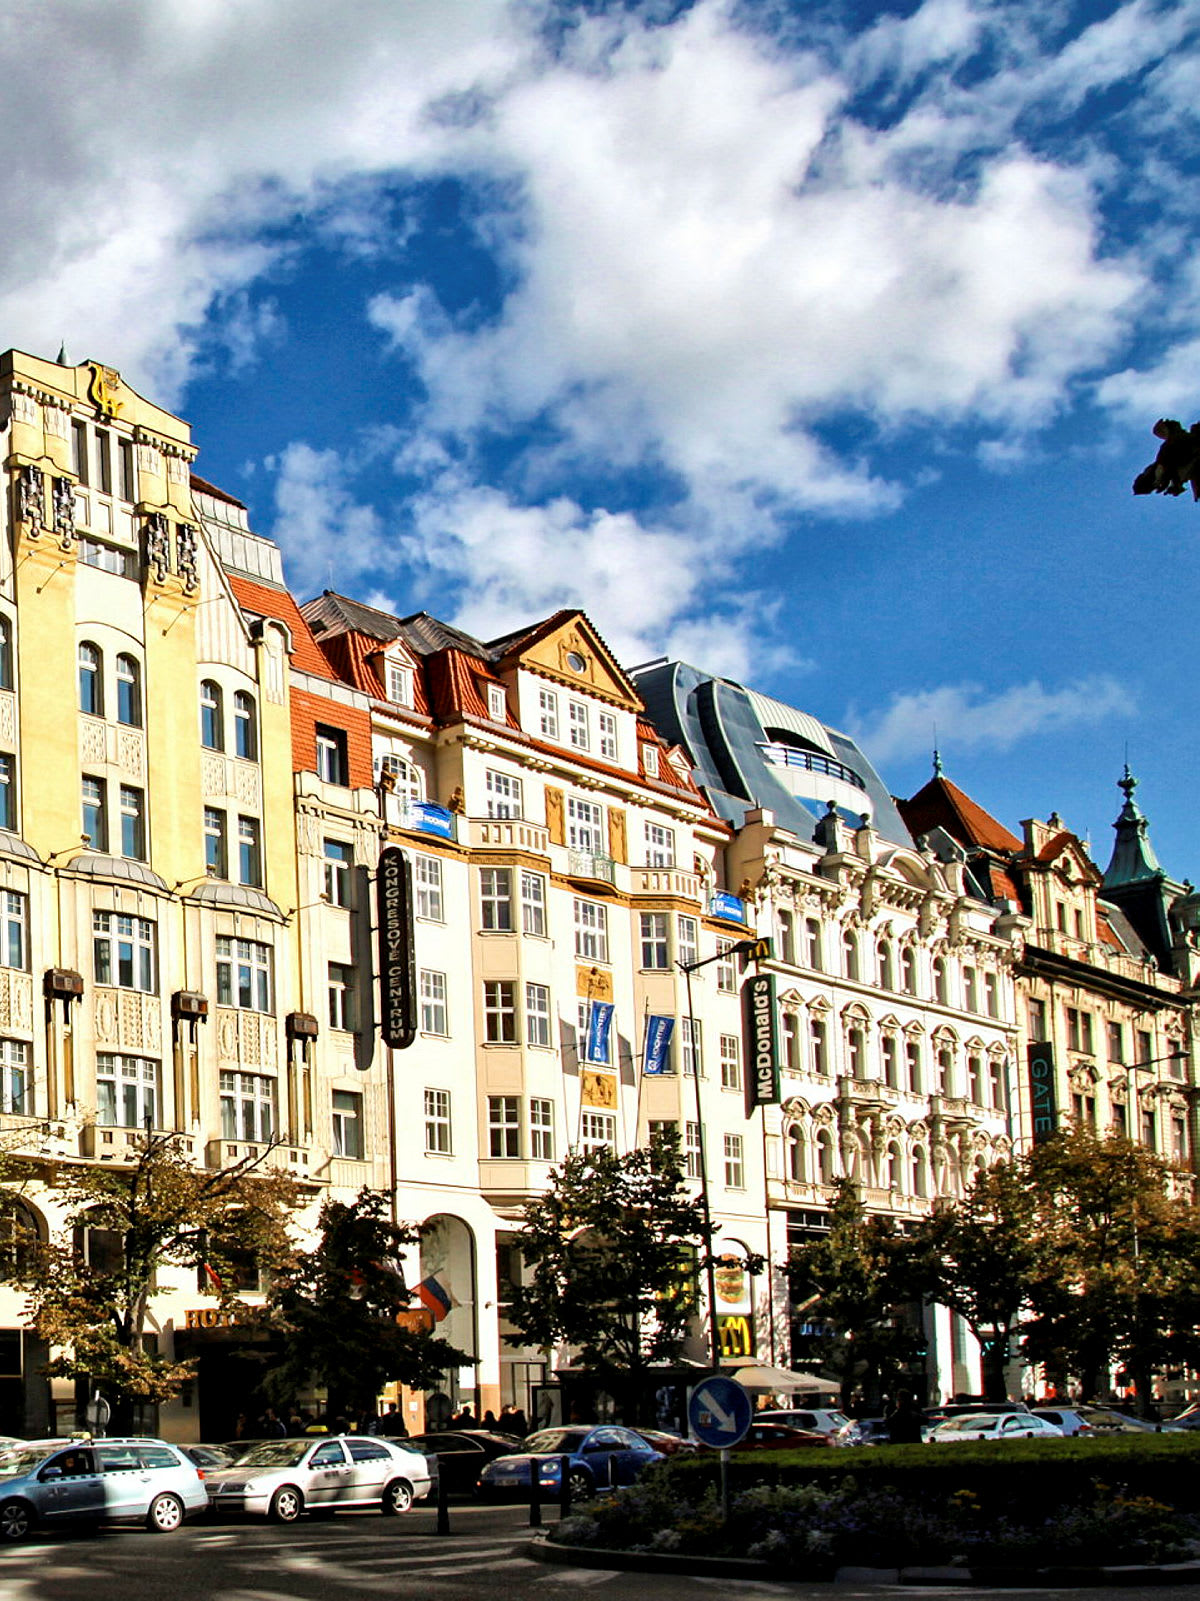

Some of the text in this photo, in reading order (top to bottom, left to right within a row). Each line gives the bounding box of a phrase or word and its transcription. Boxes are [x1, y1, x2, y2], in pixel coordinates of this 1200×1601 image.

[388, 966, 405, 1040] CENTRUM
[755, 980, 773, 1098] McDonald's
[183, 1308, 250, 1329] HOT
